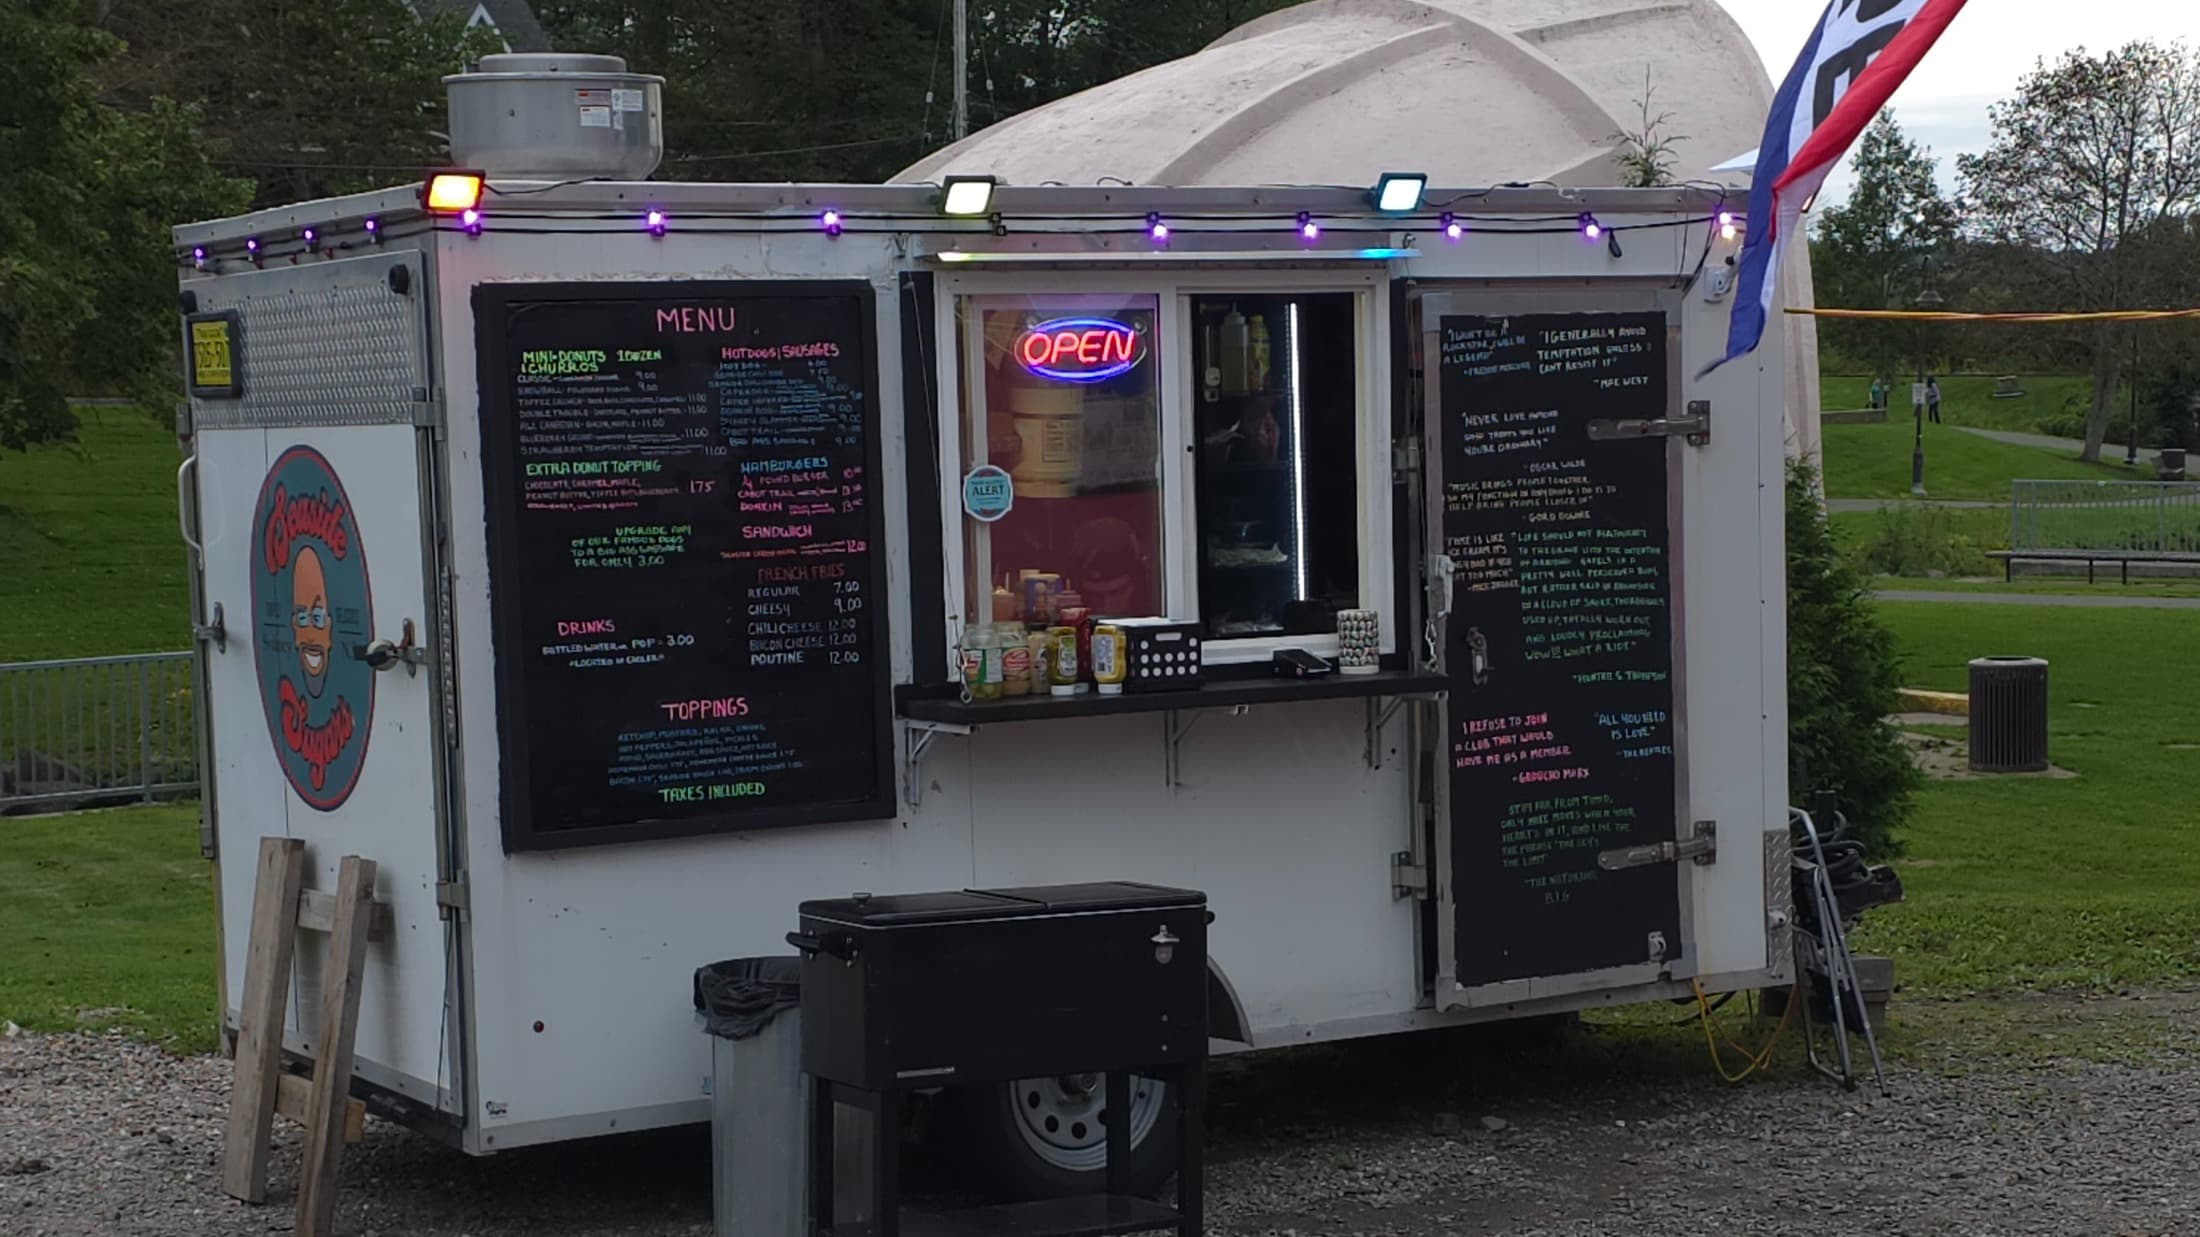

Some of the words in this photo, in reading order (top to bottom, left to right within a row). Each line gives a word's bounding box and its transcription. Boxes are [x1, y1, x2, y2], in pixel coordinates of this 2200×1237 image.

[656, 307, 735, 332] MENU
[1550, 327, 1616, 344] GENERALLY
[1618, 325, 1647, 337] AVOID
[1023, 329, 1136, 366] OPEN
[1536, 345, 1600, 360] TEMPTATION
[1565, 358, 1597, 372] RESIST
[1622, 376, 1649, 386] WEST
[525, 463, 572, 476] EXTRA
[573, 462, 608, 474] DONUT
[612, 459, 662, 472] TOPPING
[740, 456, 829, 474] HAMBURGERS
[972, 484, 1004, 496] ALERT
[741, 524, 813, 539] SANDWICH
[575, 557, 597, 568] FOR
[601, 556, 632, 567] ONLY
[757, 566, 808, 582] FRENCH
[1520, 570, 1555, 582] PRETTY
[1559, 569, 1583, 579] WELL
[747, 585, 800, 598] REGULAR
[833, 580, 860, 594] 7.00
[747, 602, 791, 616] CHEESY
[557, 619, 616, 637] DRINKS
[631, 638, 657, 649] POP
[751, 651, 805, 666] POUTINE
[660, 696, 750, 721] TOPPINGS
[1469, 716, 1506, 734] REFUSE
[1509, 715, 1522, 727] TO
[1523, 711, 1548, 727] JOIN
[1620, 712, 1641, 725] YOU
[1455, 743, 1464, 752] A
[1464, 739, 1491, 752] CLUB
[1492, 734, 1517, 747] THAT
[1519, 731, 1554, 744] WOULD
[1611, 729, 1623, 741] IS
[1456, 755, 1482, 769] HAVE
[1486, 754, 1500, 766] ME
[1503, 752, 1518, 764] AS
[1519, 750, 1528, 761] A
[1529, 745, 1573, 760] MEMBER
[1562, 767, 1591, 780] MARX
[657, 785, 705, 803] TAXES
[708, 781, 767, 801] INCLUDED
[1554, 796, 1580, 809] FROM
